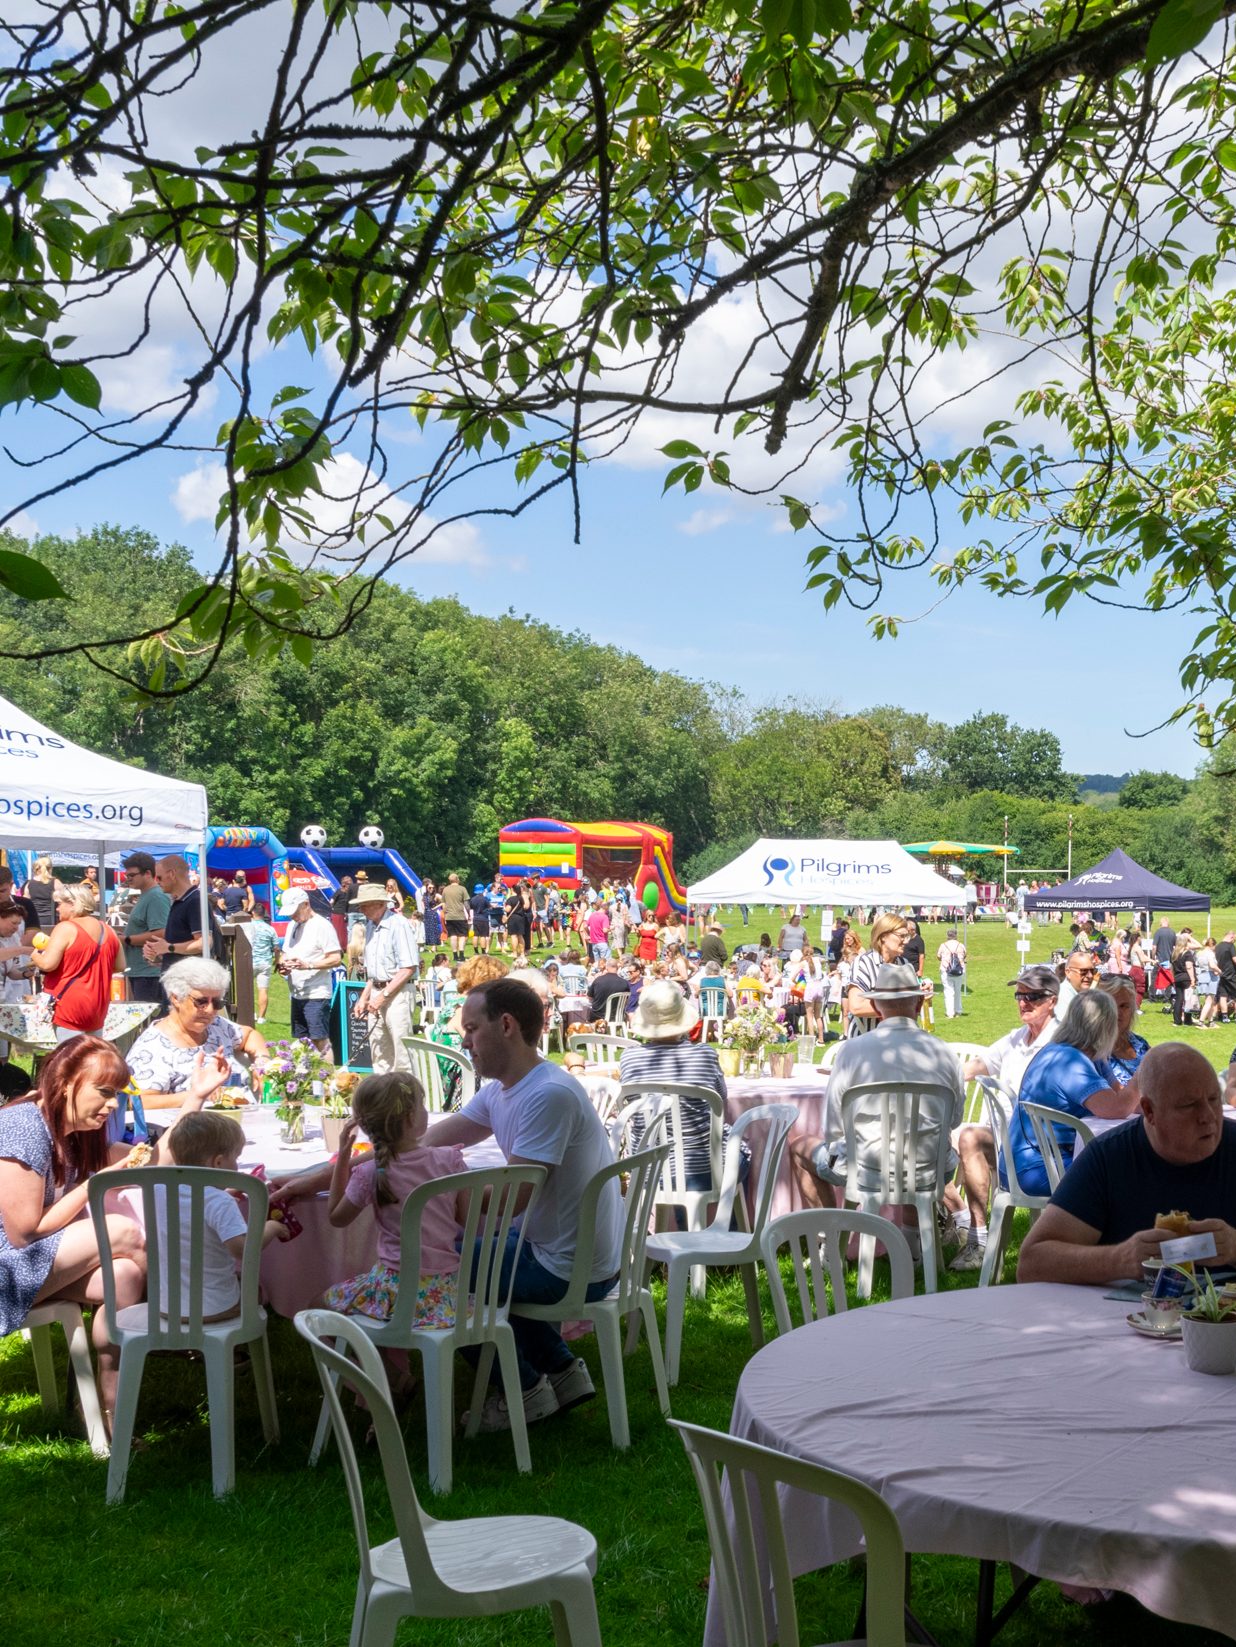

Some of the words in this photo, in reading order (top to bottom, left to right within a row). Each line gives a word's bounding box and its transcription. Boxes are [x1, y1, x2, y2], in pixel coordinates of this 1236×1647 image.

[800, 858, 892, 877] Pilgrims
[1092, 872, 1124, 881] Pilgrims
[1036, 900, 1133, 909] www.pilgrimshospices.org
